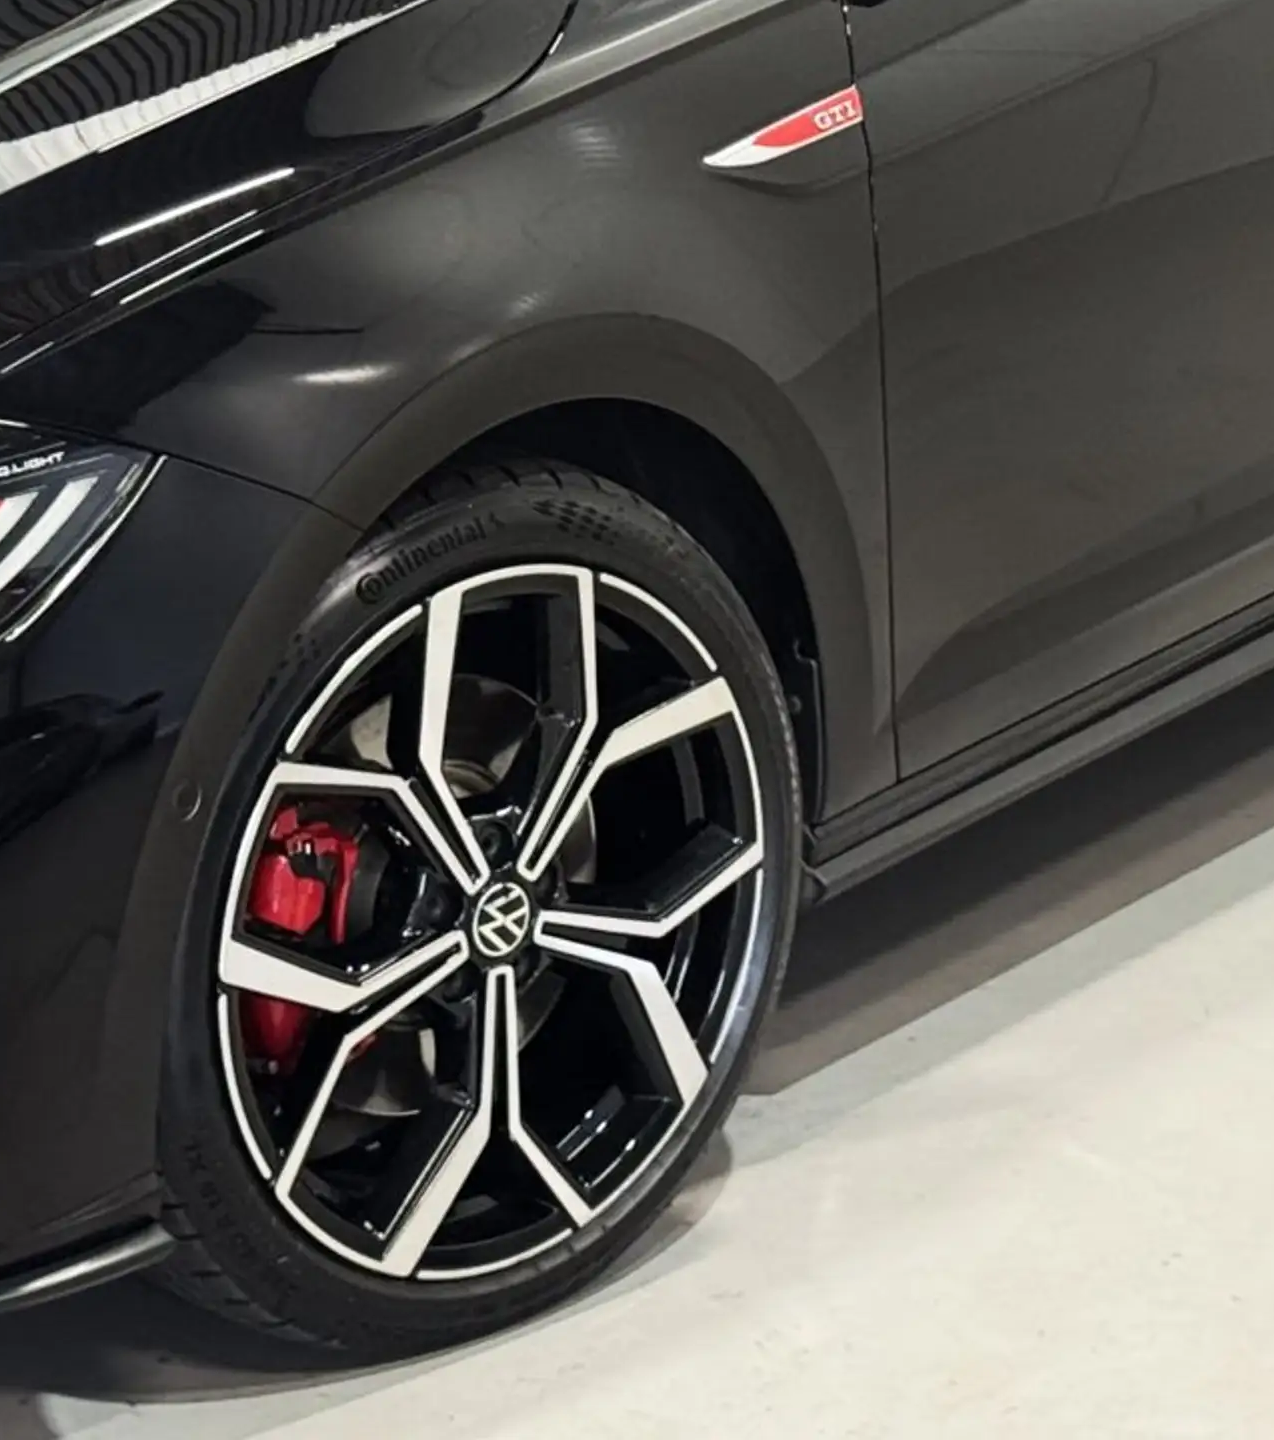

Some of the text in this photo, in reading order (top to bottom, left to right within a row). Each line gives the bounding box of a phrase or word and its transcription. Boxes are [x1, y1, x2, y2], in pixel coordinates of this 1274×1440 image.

[813, 100, 858, 131] GTI
[355, 517, 488, 605] Continental
[472, 882, 530, 957] VW
